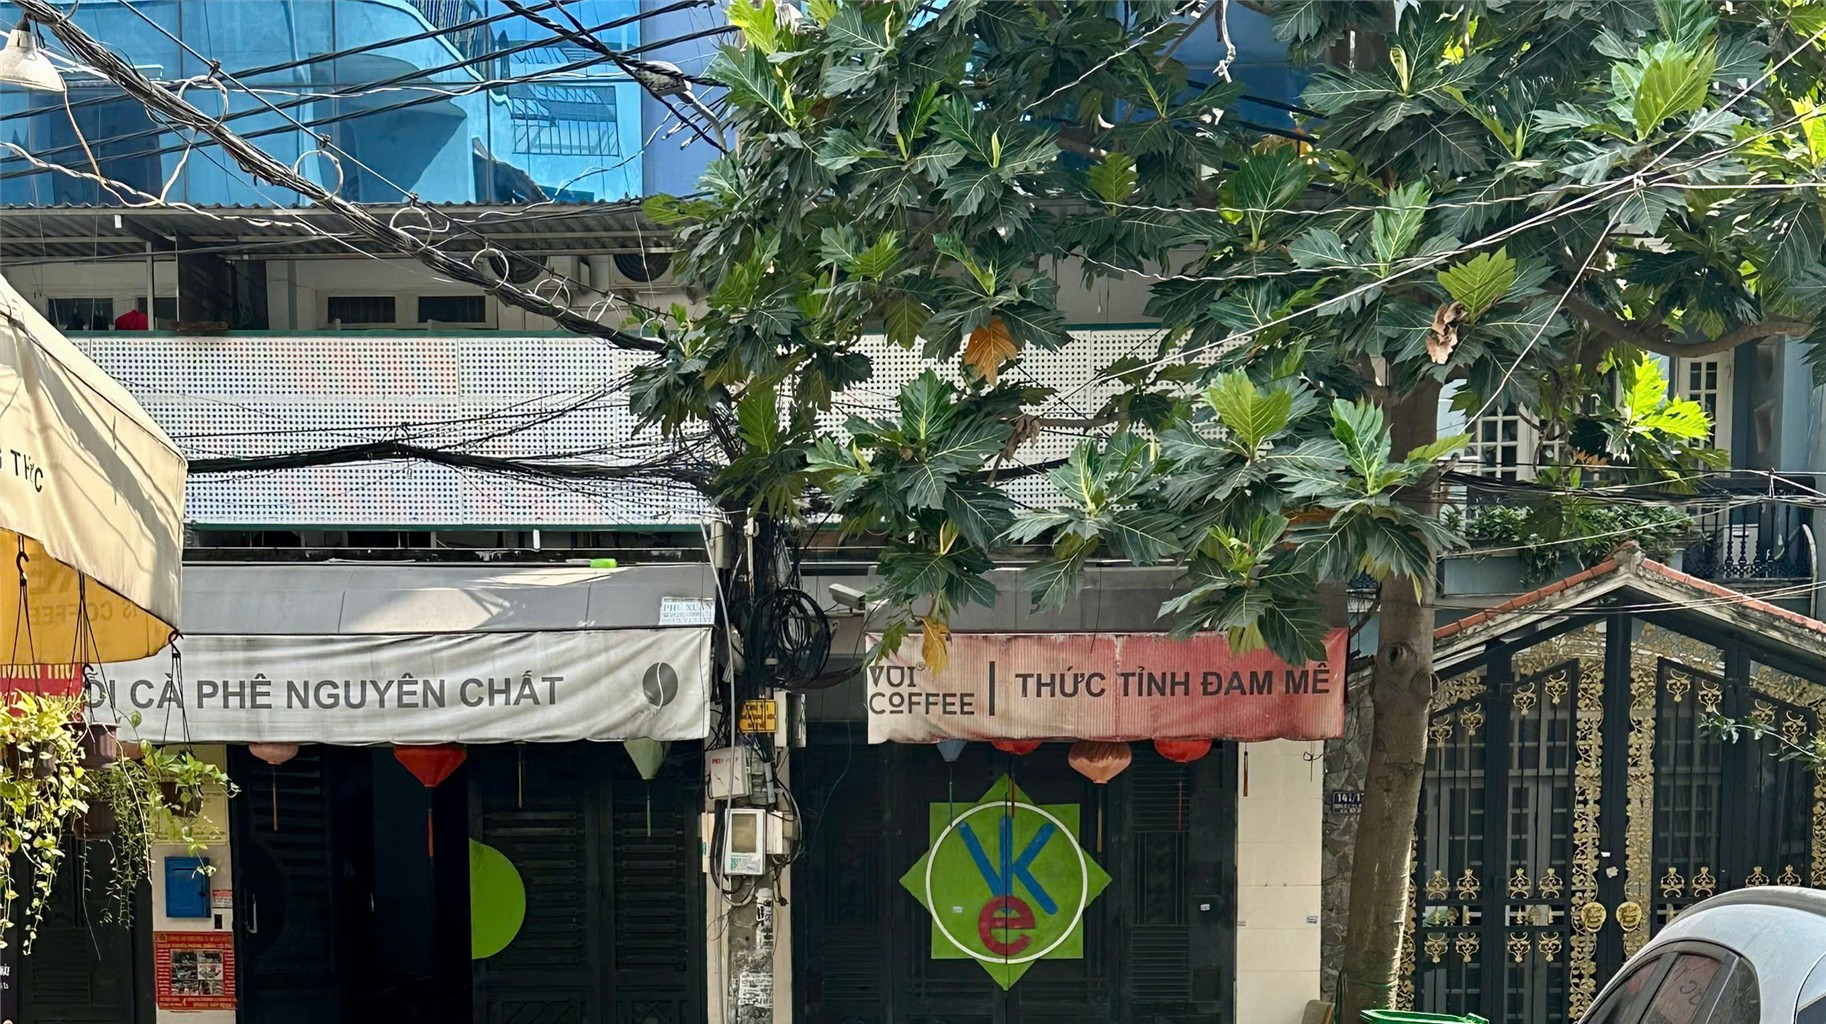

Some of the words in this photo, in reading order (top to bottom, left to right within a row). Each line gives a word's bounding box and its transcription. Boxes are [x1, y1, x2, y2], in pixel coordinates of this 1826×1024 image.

[131, 673, 183, 709] CÀ
[197, 674, 272, 709] PHÊ
[287, 672, 446, 709] NGUYÊN
[460, 670, 564, 708] CHẤT
[1015, 666, 1106, 698] THỨC
[1120, 666, 1190, 697] TỈNH
[1201, 670, 1273, 696] ĐAM
[1284, 663, 1330, 695] MÊ
[869, 692, 975, 715] COFFEE
